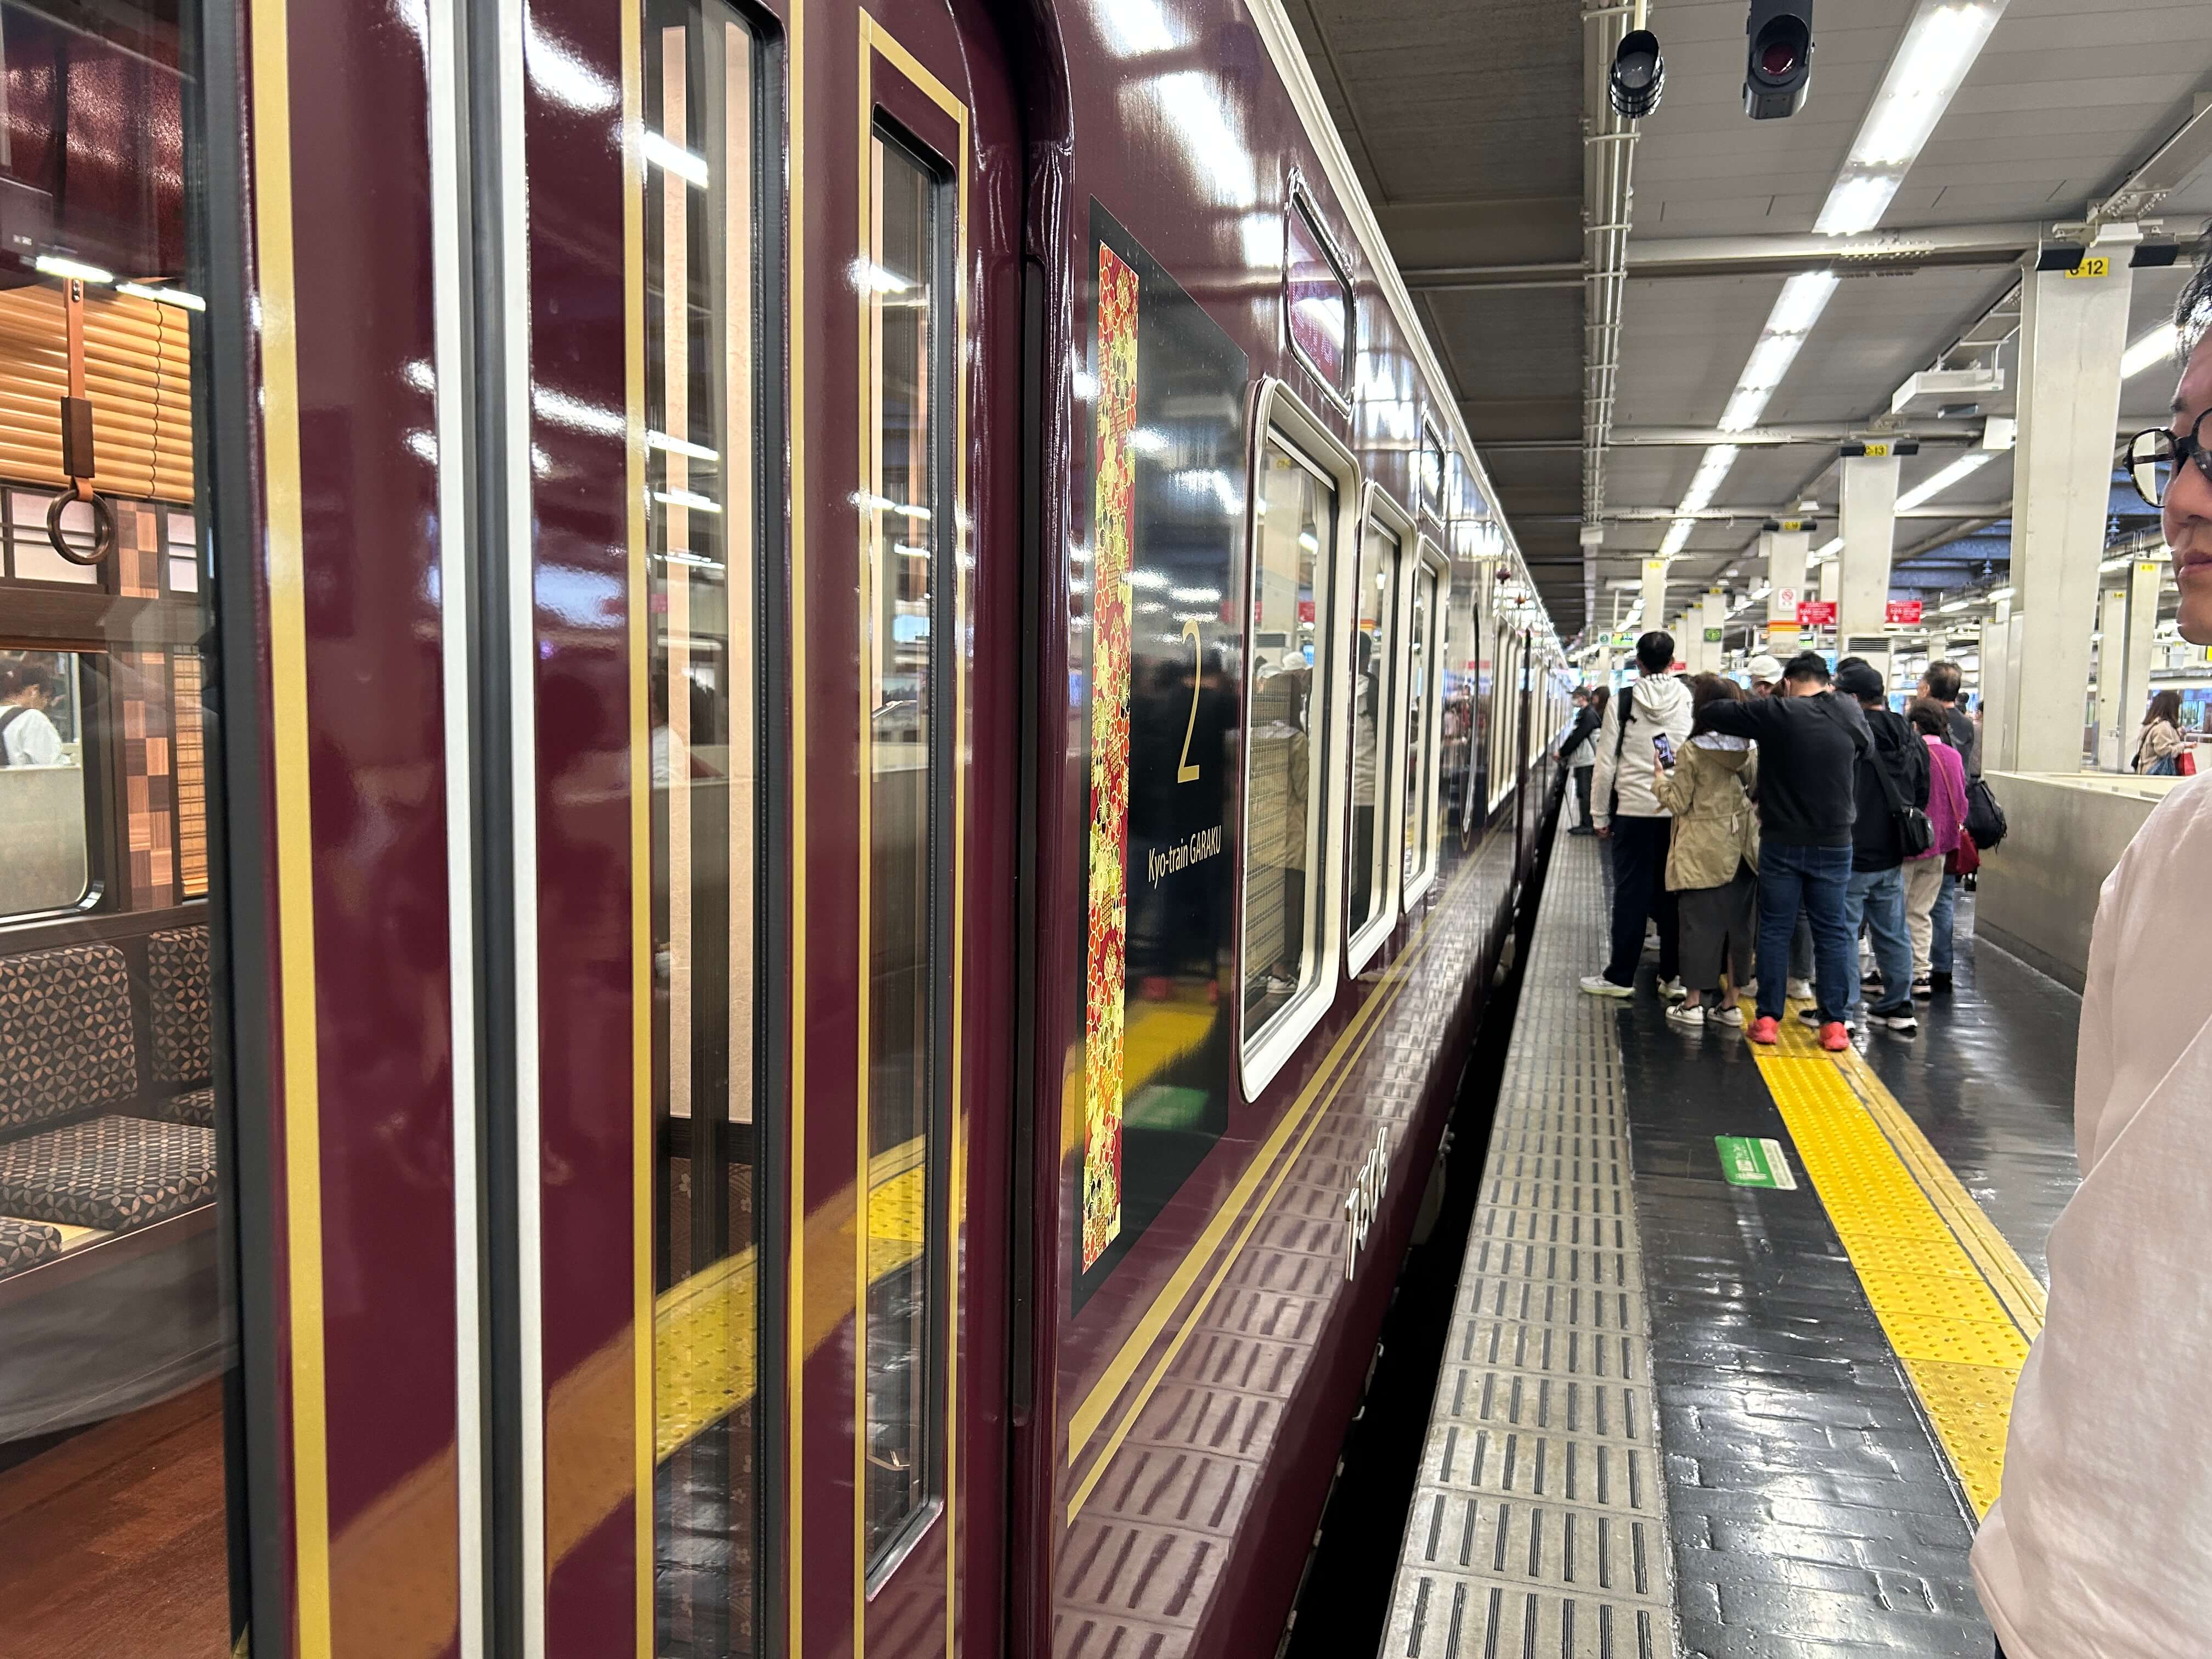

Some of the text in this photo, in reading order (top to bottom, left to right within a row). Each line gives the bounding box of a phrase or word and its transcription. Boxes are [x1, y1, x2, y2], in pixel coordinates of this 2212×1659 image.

[1177, 618, 1202, 783] 2
[1148, 825, 1221, 889] Kyo-train GARAKU
[1345, 1126, 1389, 1283] 7506
